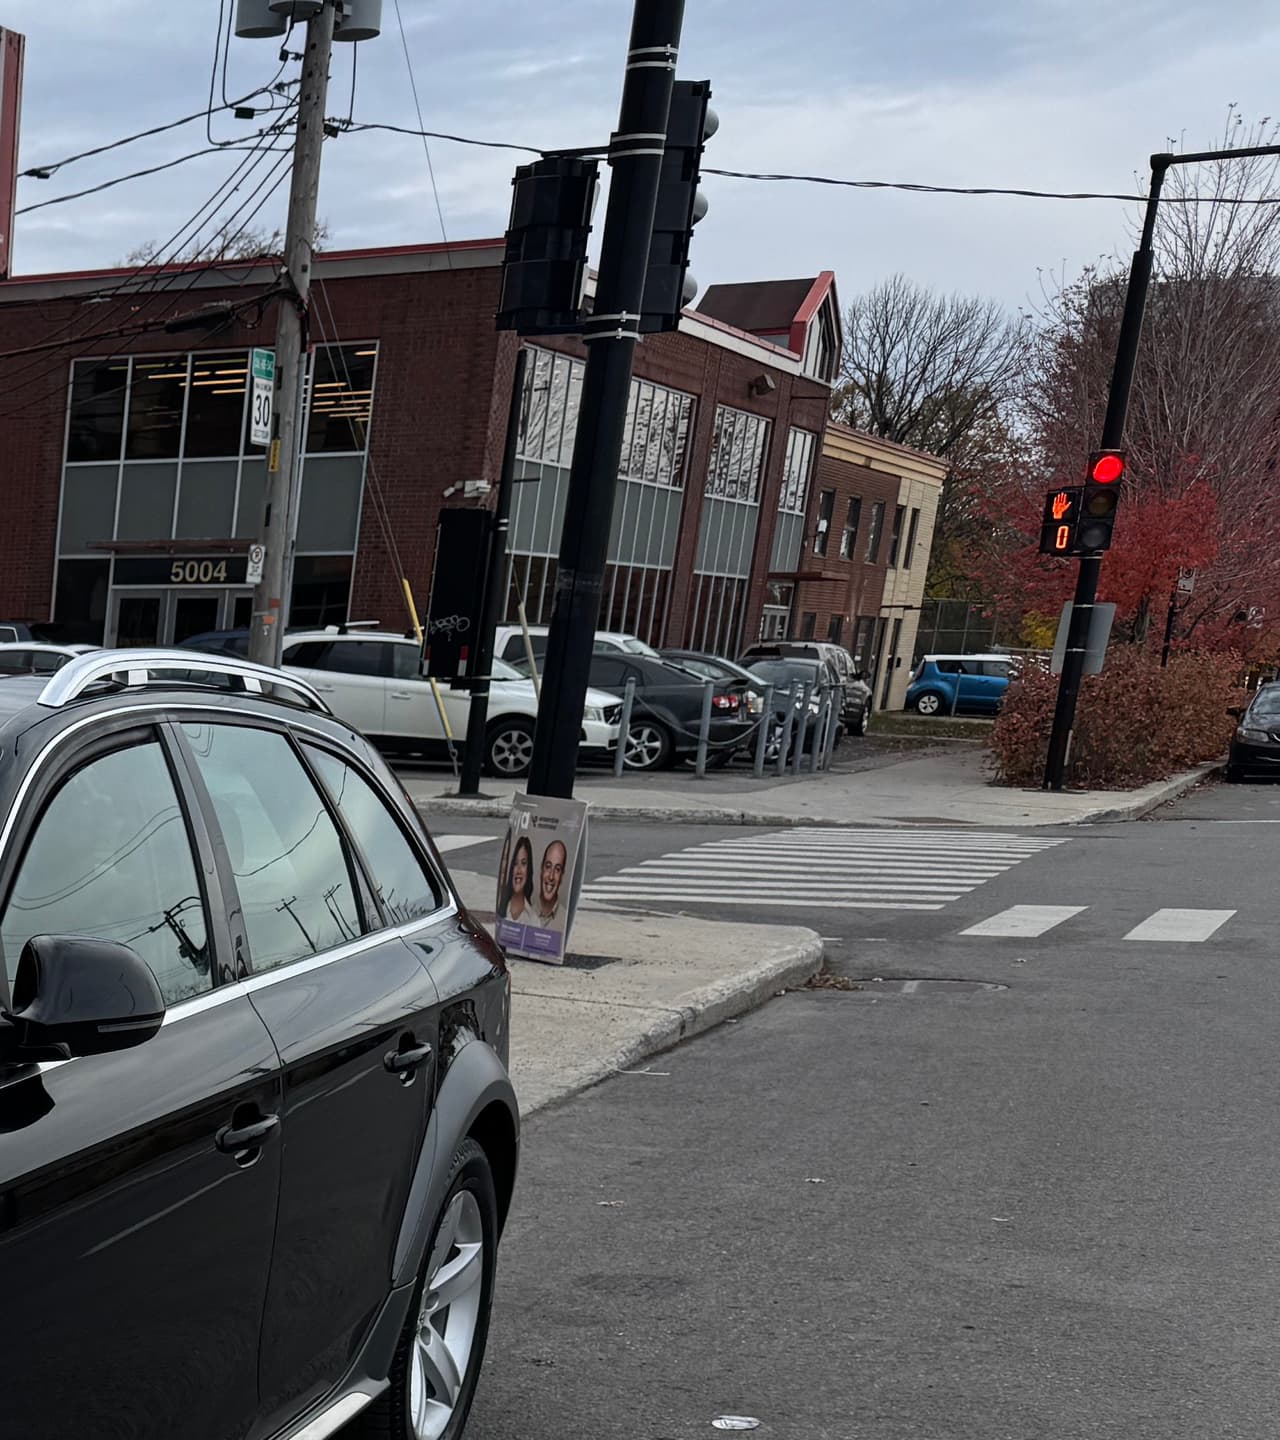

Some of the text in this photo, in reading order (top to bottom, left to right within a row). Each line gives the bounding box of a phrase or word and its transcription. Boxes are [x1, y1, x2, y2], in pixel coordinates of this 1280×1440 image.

[254, 394, 271, 428] 30
[1055, 525, 1070, 549] 0
[170, 560, 228, 582] 5004
